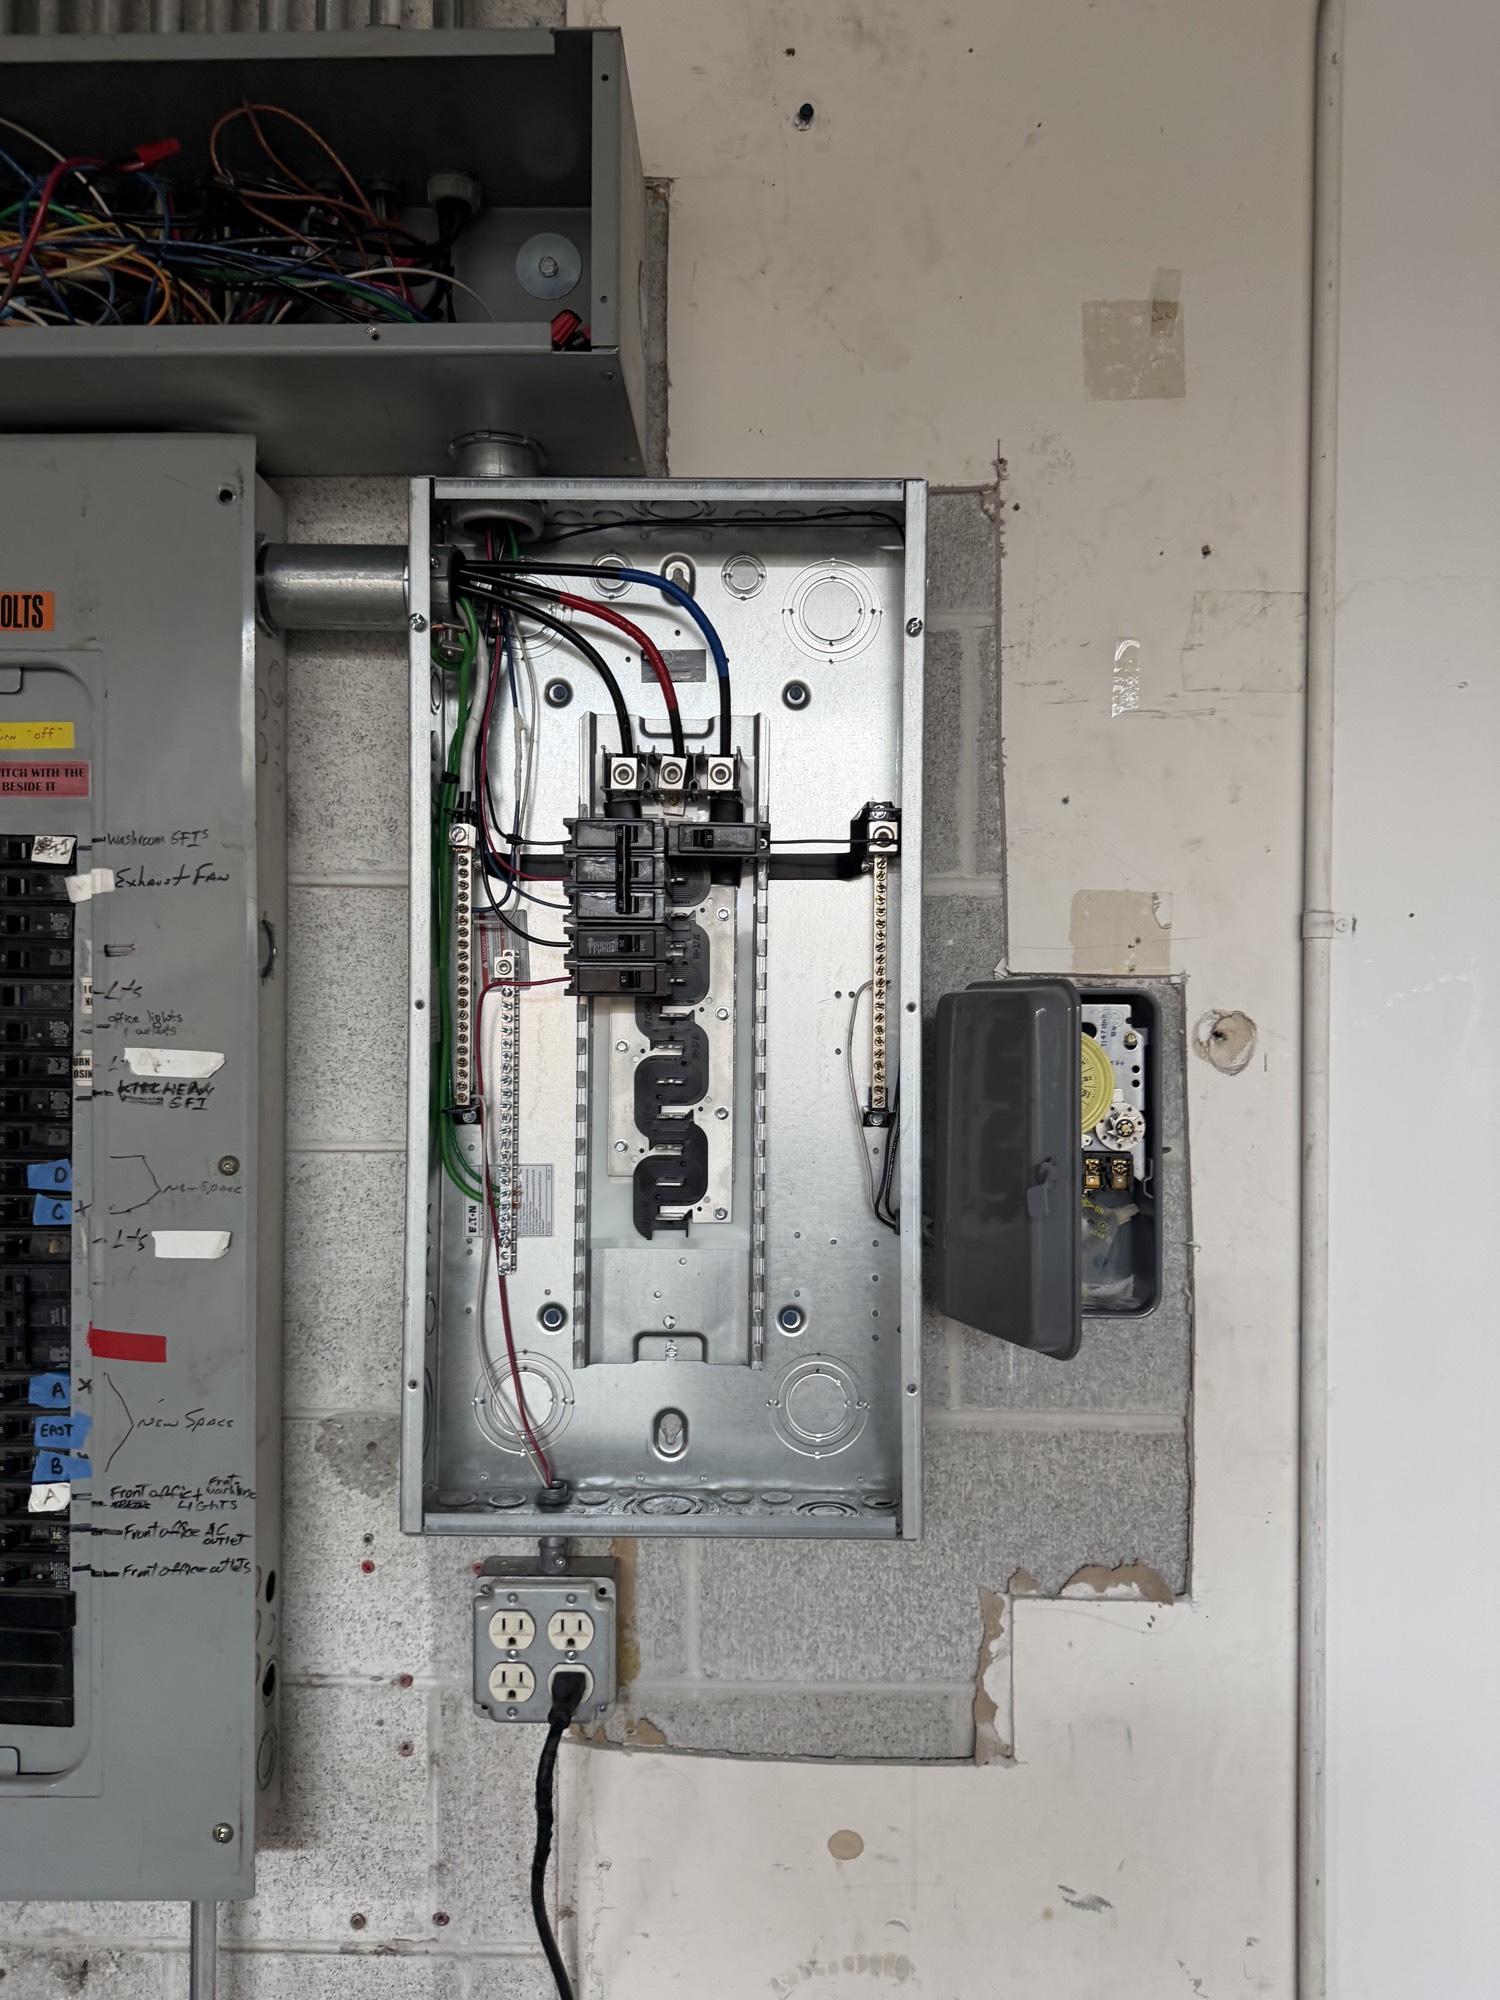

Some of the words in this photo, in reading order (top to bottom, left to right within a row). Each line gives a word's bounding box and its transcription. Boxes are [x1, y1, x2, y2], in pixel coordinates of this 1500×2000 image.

[31, 768, 60, 778] WITH
[64, 768, 86, 778] THE
[2, 781, 43, 792] BESIDE
[46, 781, 57, 792] IT
[54, 1167, 67, 1183] D
[52, 1203, 64, 1220] C
[52, 1381, 65, 1399] A
[40, 1423, 74, 1438] EAST
[51, 1457, 64, 1475] B
[43, 1487, 62, 1506] A
[51, 1531, 62, 1540] 16
